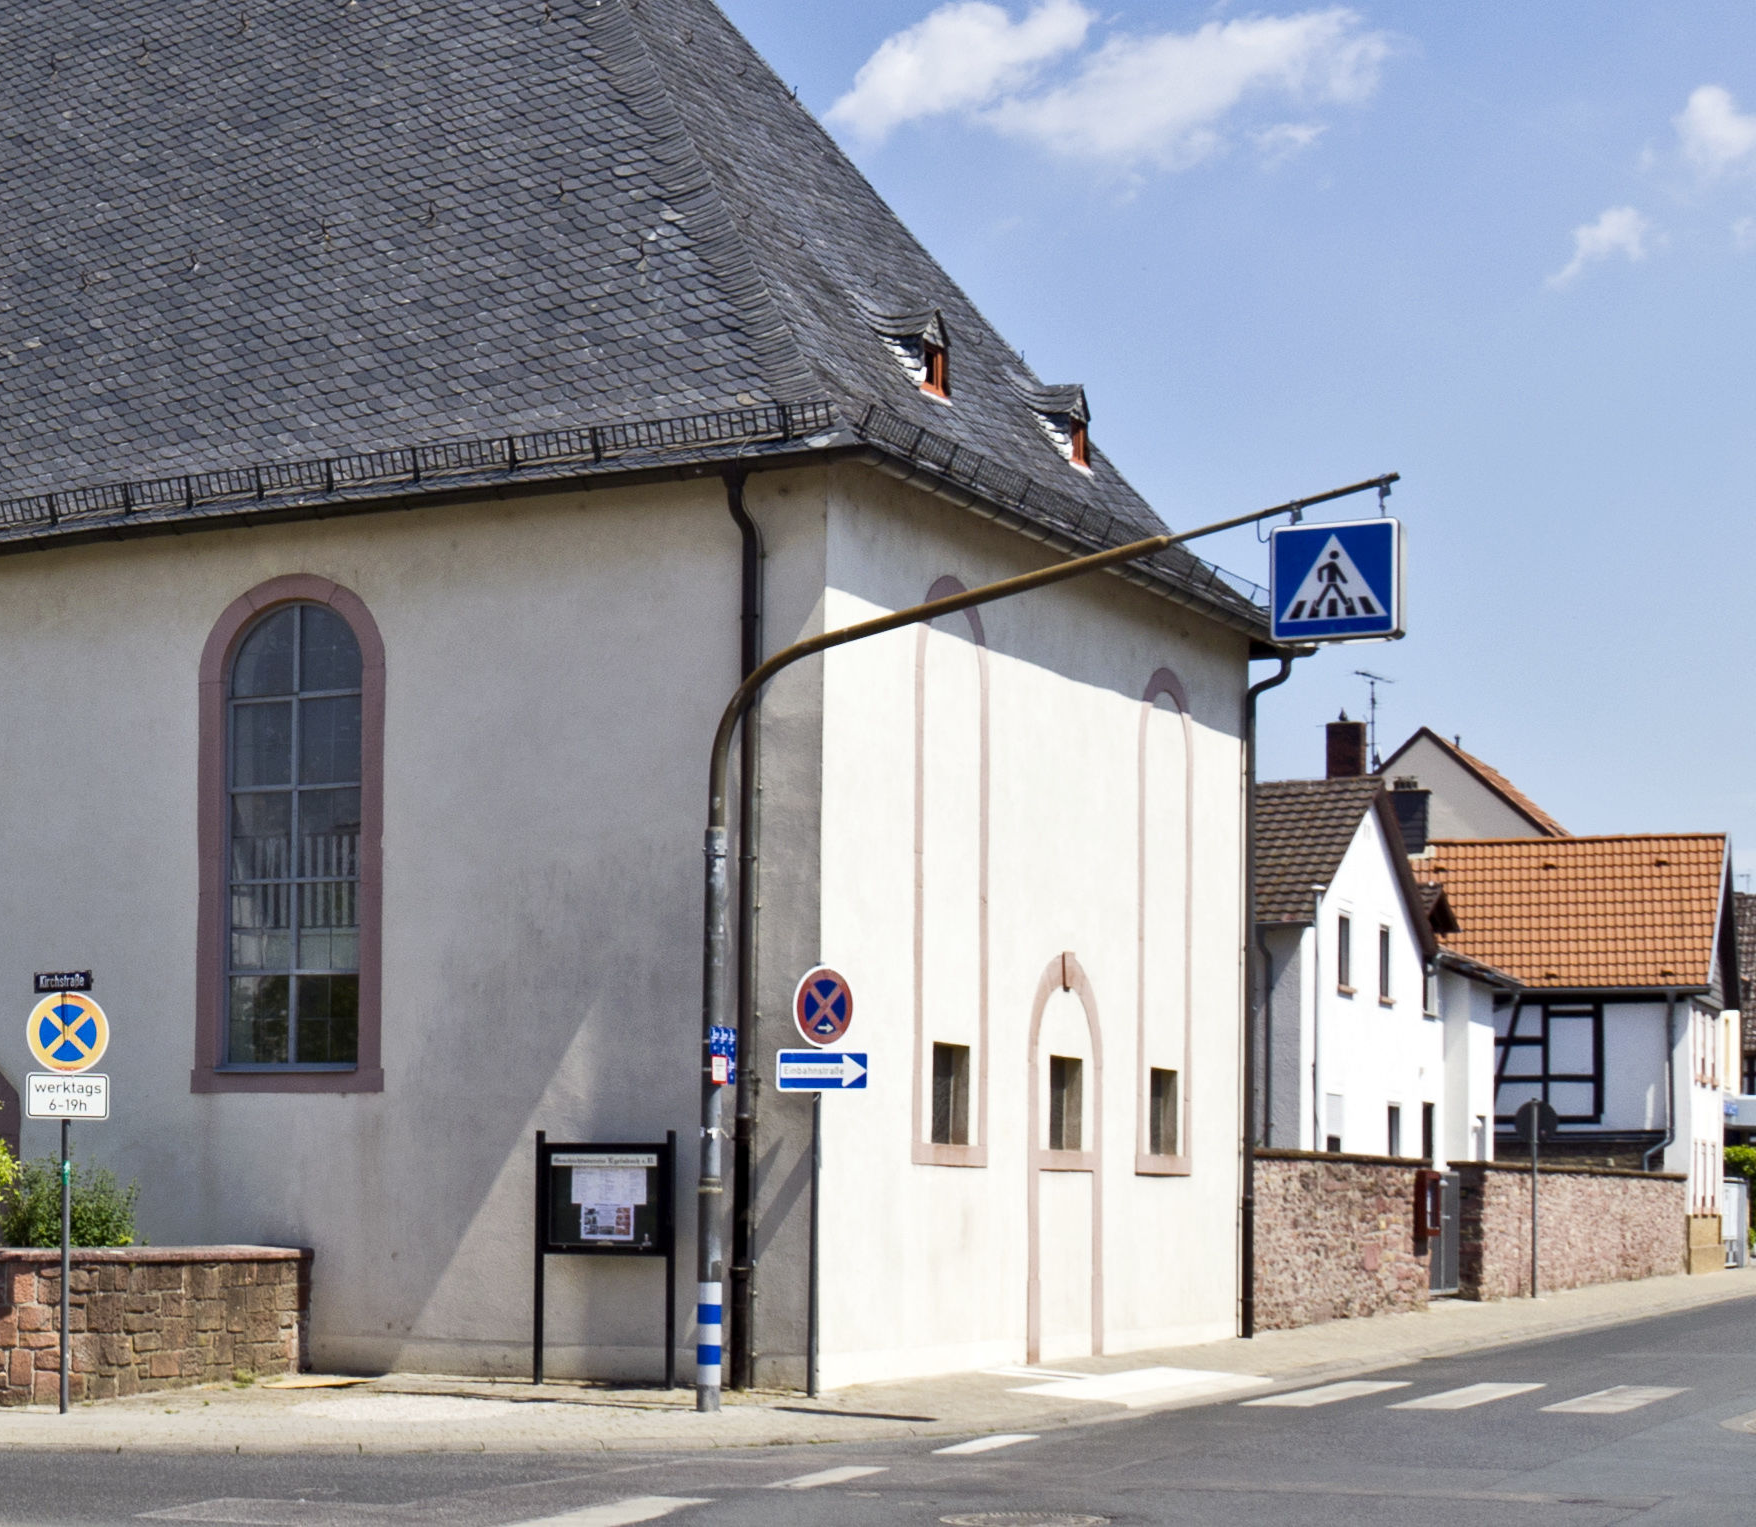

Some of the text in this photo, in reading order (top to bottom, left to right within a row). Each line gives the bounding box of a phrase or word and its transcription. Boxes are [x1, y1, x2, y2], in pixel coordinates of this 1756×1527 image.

[39, 975, 84, 988] Kirchstraße
[783, 1065, 844, 1075] Einbahnstraße
[34, 1082, 102, 1097] werktags
[48, 1099, 87, 1112] 6-19h
